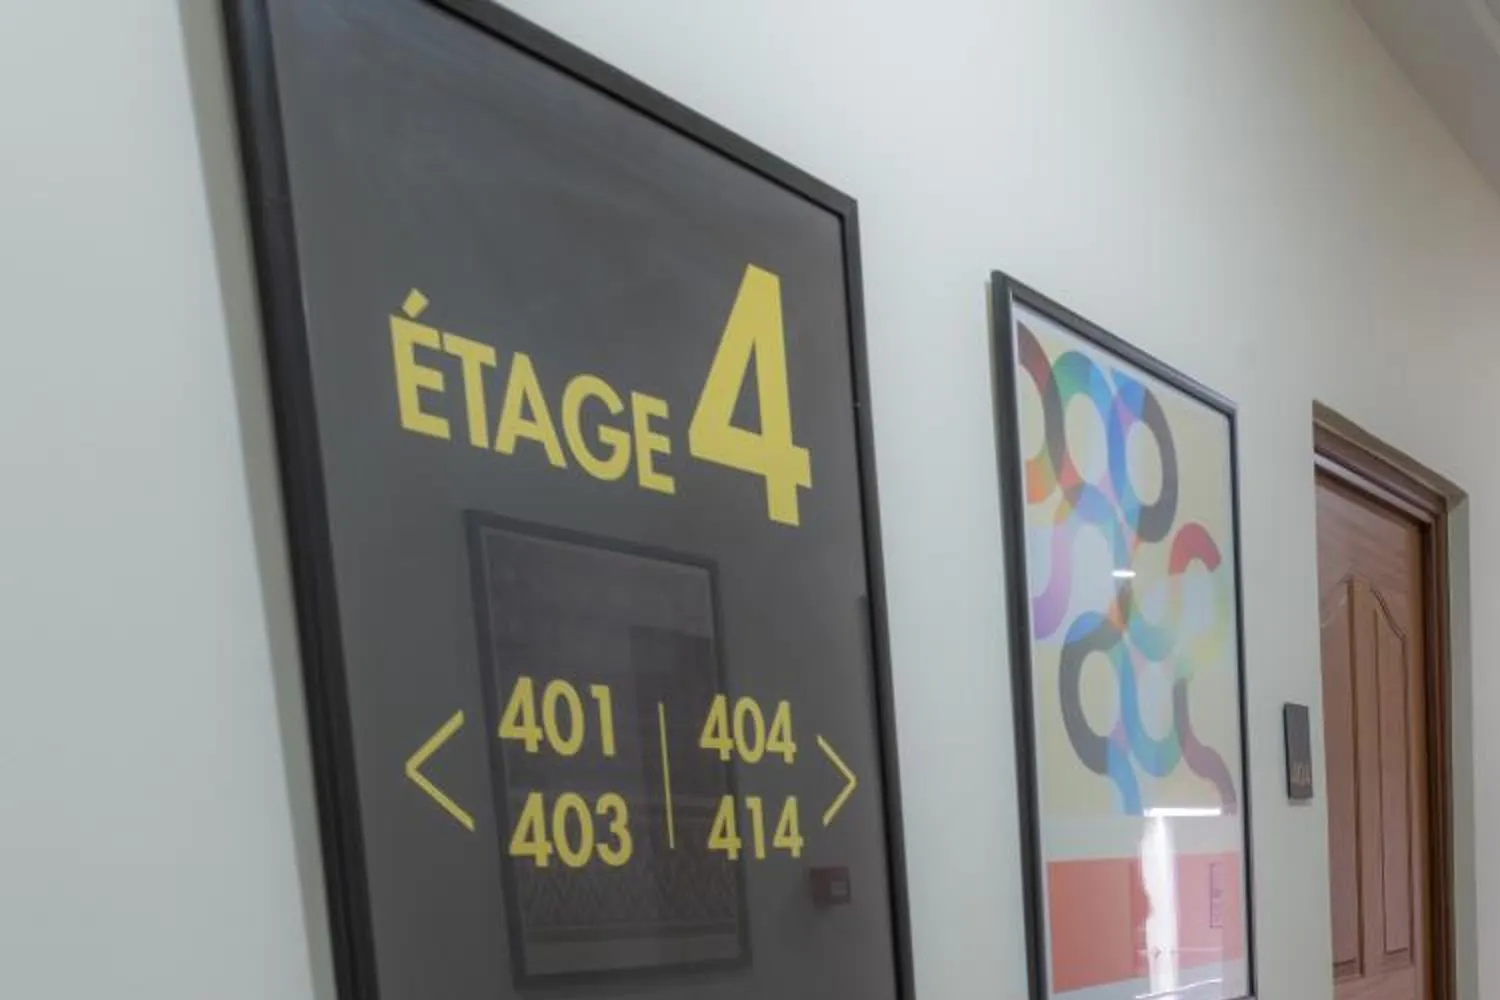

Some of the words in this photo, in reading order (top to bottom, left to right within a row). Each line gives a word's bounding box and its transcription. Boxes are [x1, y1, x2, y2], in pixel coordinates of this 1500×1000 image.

[389, 288, 676, 495] ÉTAGE
[687, 263, 813, 527] 4
[498, 675, 616, 758] 401
[699, 694, 797, 765] 404
[510, 791, 634, 869] 403
[708, 794, 804, 861] 414
